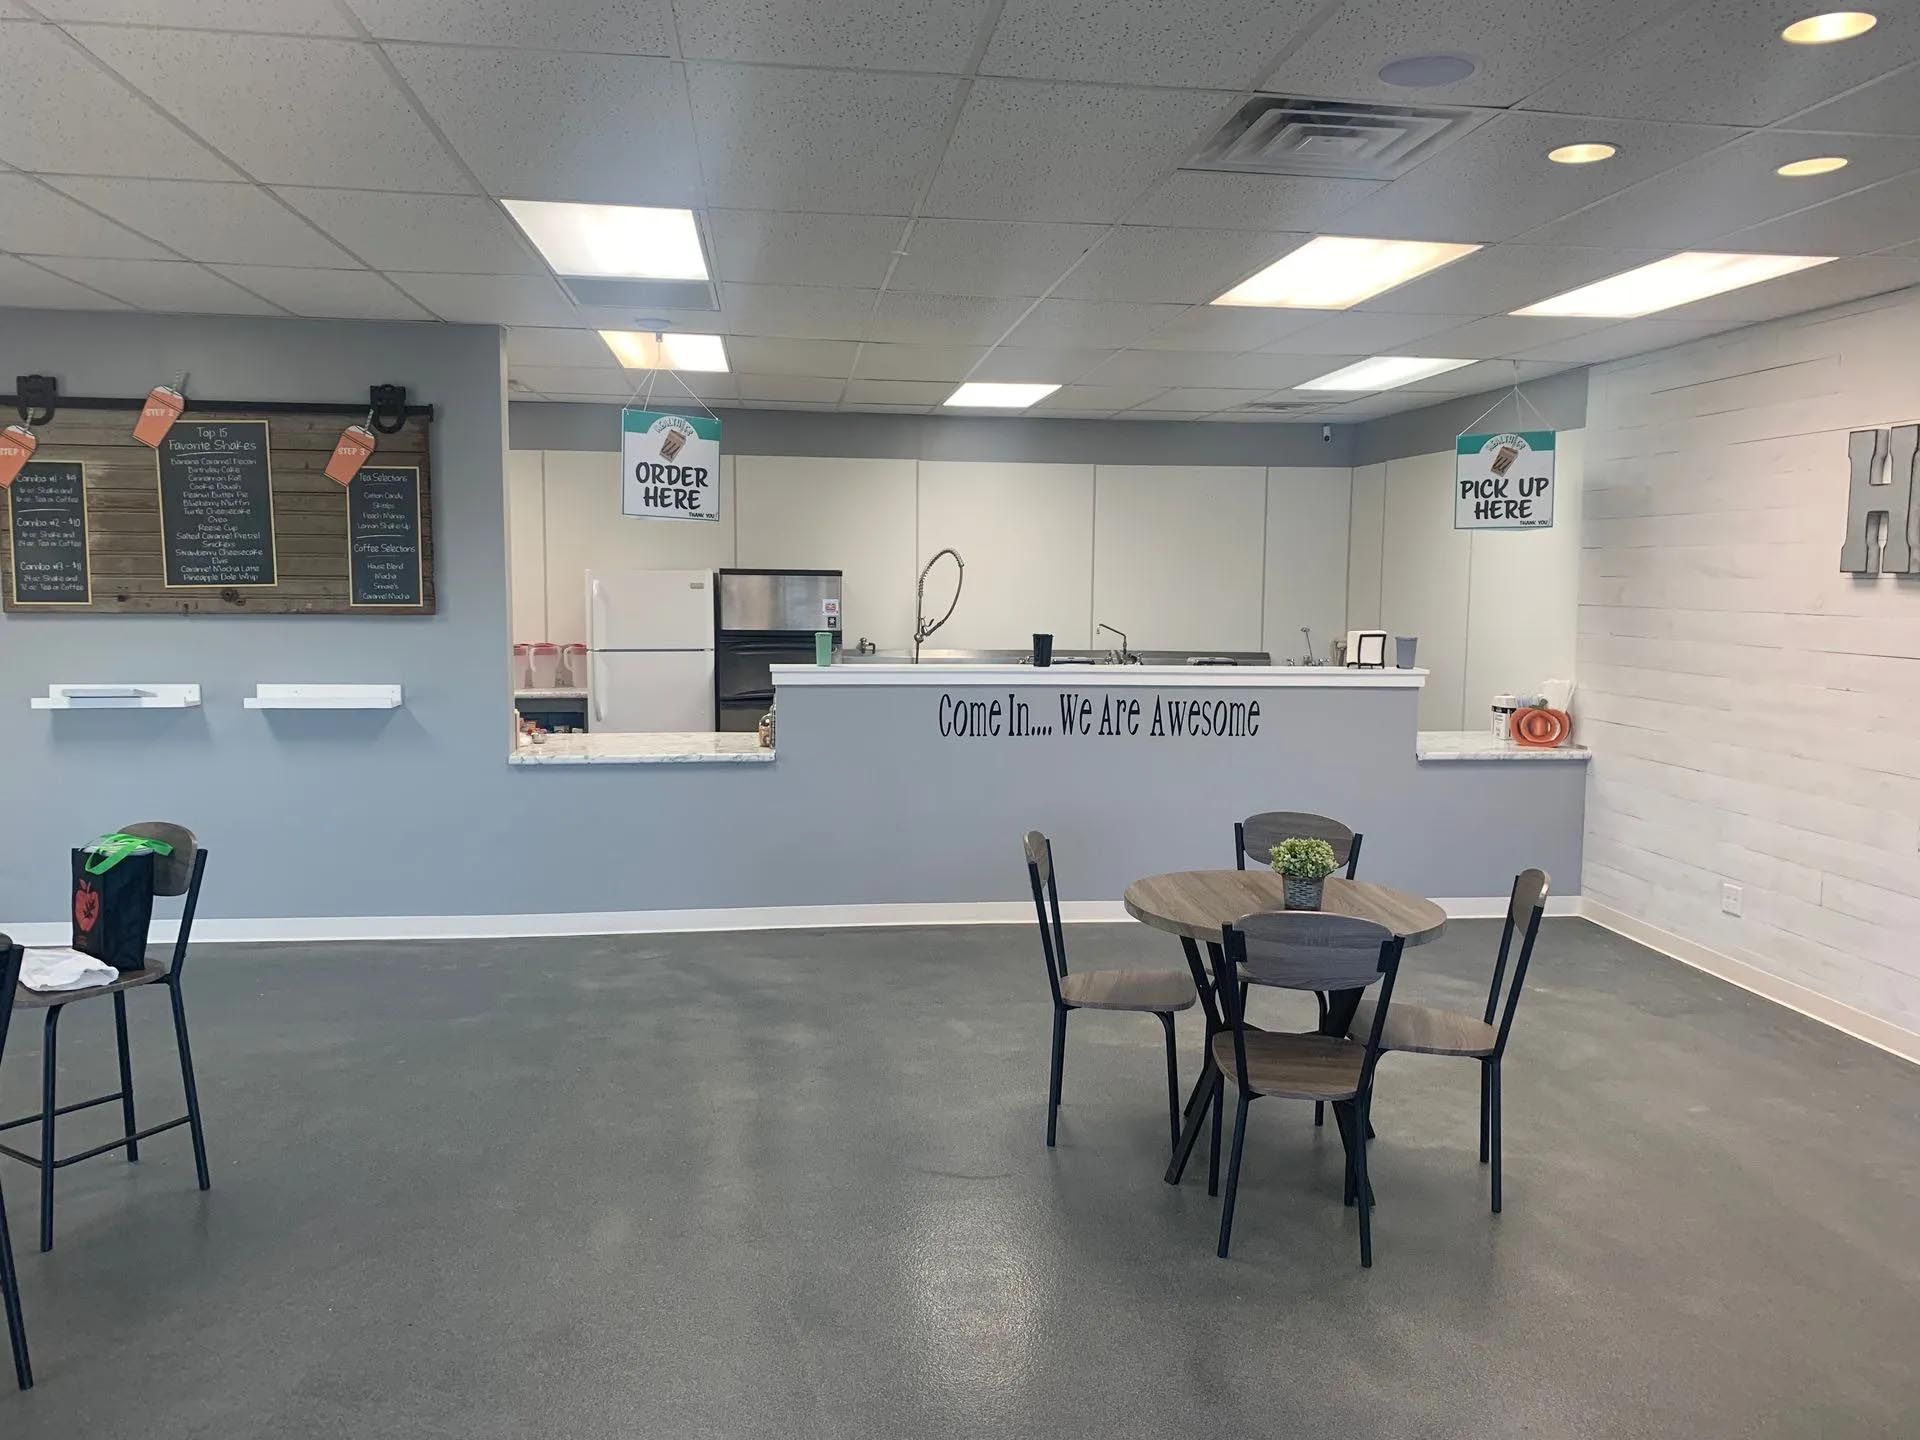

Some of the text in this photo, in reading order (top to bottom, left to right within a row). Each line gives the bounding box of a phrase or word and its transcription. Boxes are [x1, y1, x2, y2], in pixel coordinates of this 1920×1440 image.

[144, 408, 175, 417] STEP 2
[196, 427, 228, 440] Top 15
[168, 440, 257, 451] Favorite Shakes
[337, 448, 366, 456] STEP 3
[188, 466, 220, 474] Birthday
[16, 474, 46, 483] Combo
[360, 473, 408, 482] Tea Selections
[636, 462, 708, 488] ORDER
[1460, 477, 1549, 500] PICK UP
[385, 492, 404, 500] Candy
[643, 486, 701, 510] HERE
[183, 499, 220, 507] Blueberry
[1474, 499, 1533, 520] HERE
[383, 512, 405, 520] Mango
[17, 518, 47, 527] Combo
[49, 518, 60, 527] #2
[68, 518, 80, 527] $10
[198, 524, 238, 532] Reese Cup
[40, 530, 61, 538] Shake
[176, 532, 200, 540] Salted
[202, 532, 233, 540] Caramel
[38, 539, 49, 547] Tea
[354, 544, 416, 553] Coffee Selections
[20, 562, 50, 571] Combo
[53, 562, 64, 571] #3
[72, 562, 82, 571] $11
[180, 565, 212, 573] Caramel
[184, 573, 218, 582] Pineapple
[239, 573, 258, 582] Whip
[40, 583, 52, 591] Tea
[61, 583, 84, 591] Coffee
[939, 694, 1261, 737] Come In.... We Are Awesome
